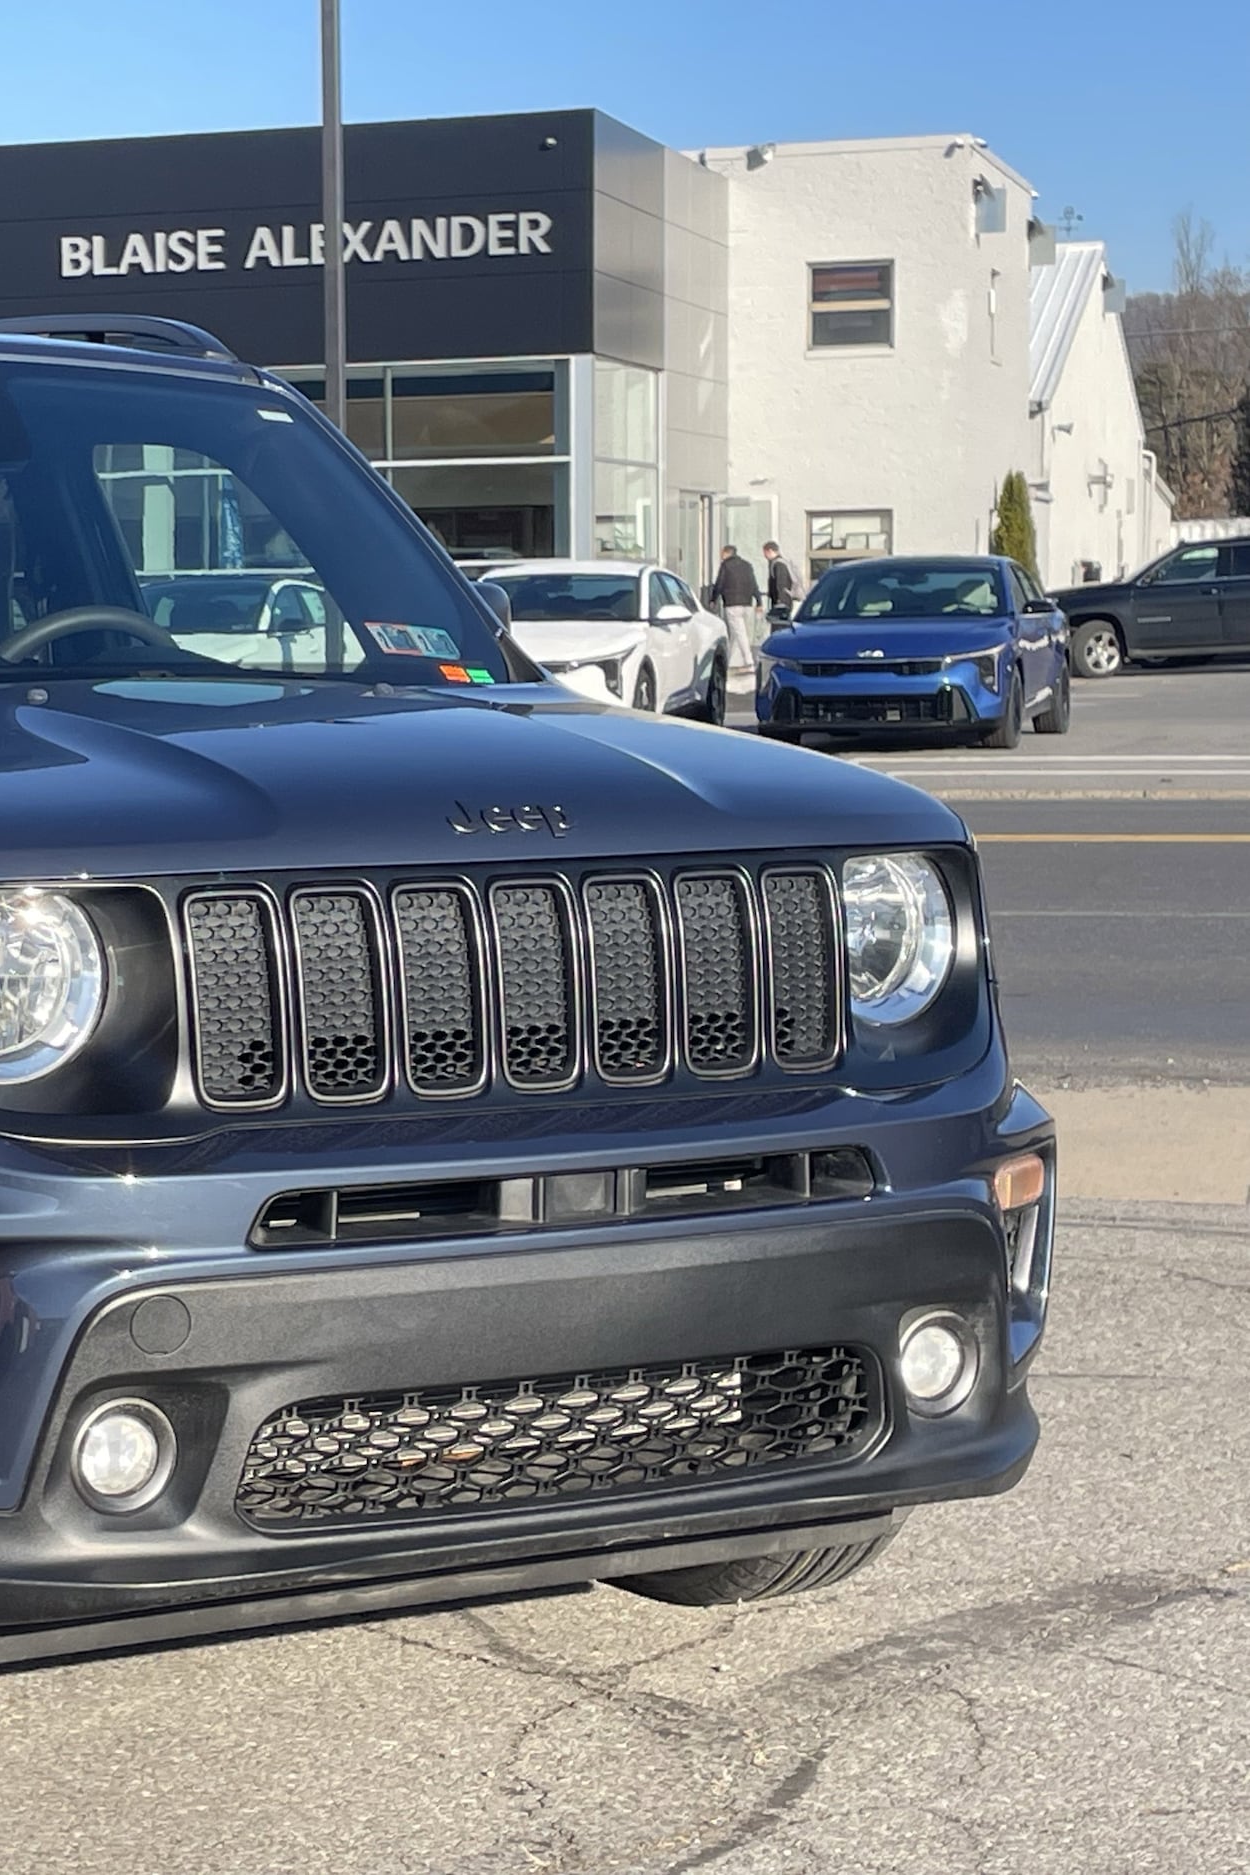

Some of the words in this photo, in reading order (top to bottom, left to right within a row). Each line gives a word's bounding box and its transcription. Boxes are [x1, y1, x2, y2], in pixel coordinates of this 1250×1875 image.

[60, 228, 227, 278] BLAISE
[244, 211, 553, 270] ALEXANDER
[445, 799, 574, 839] Jeep
